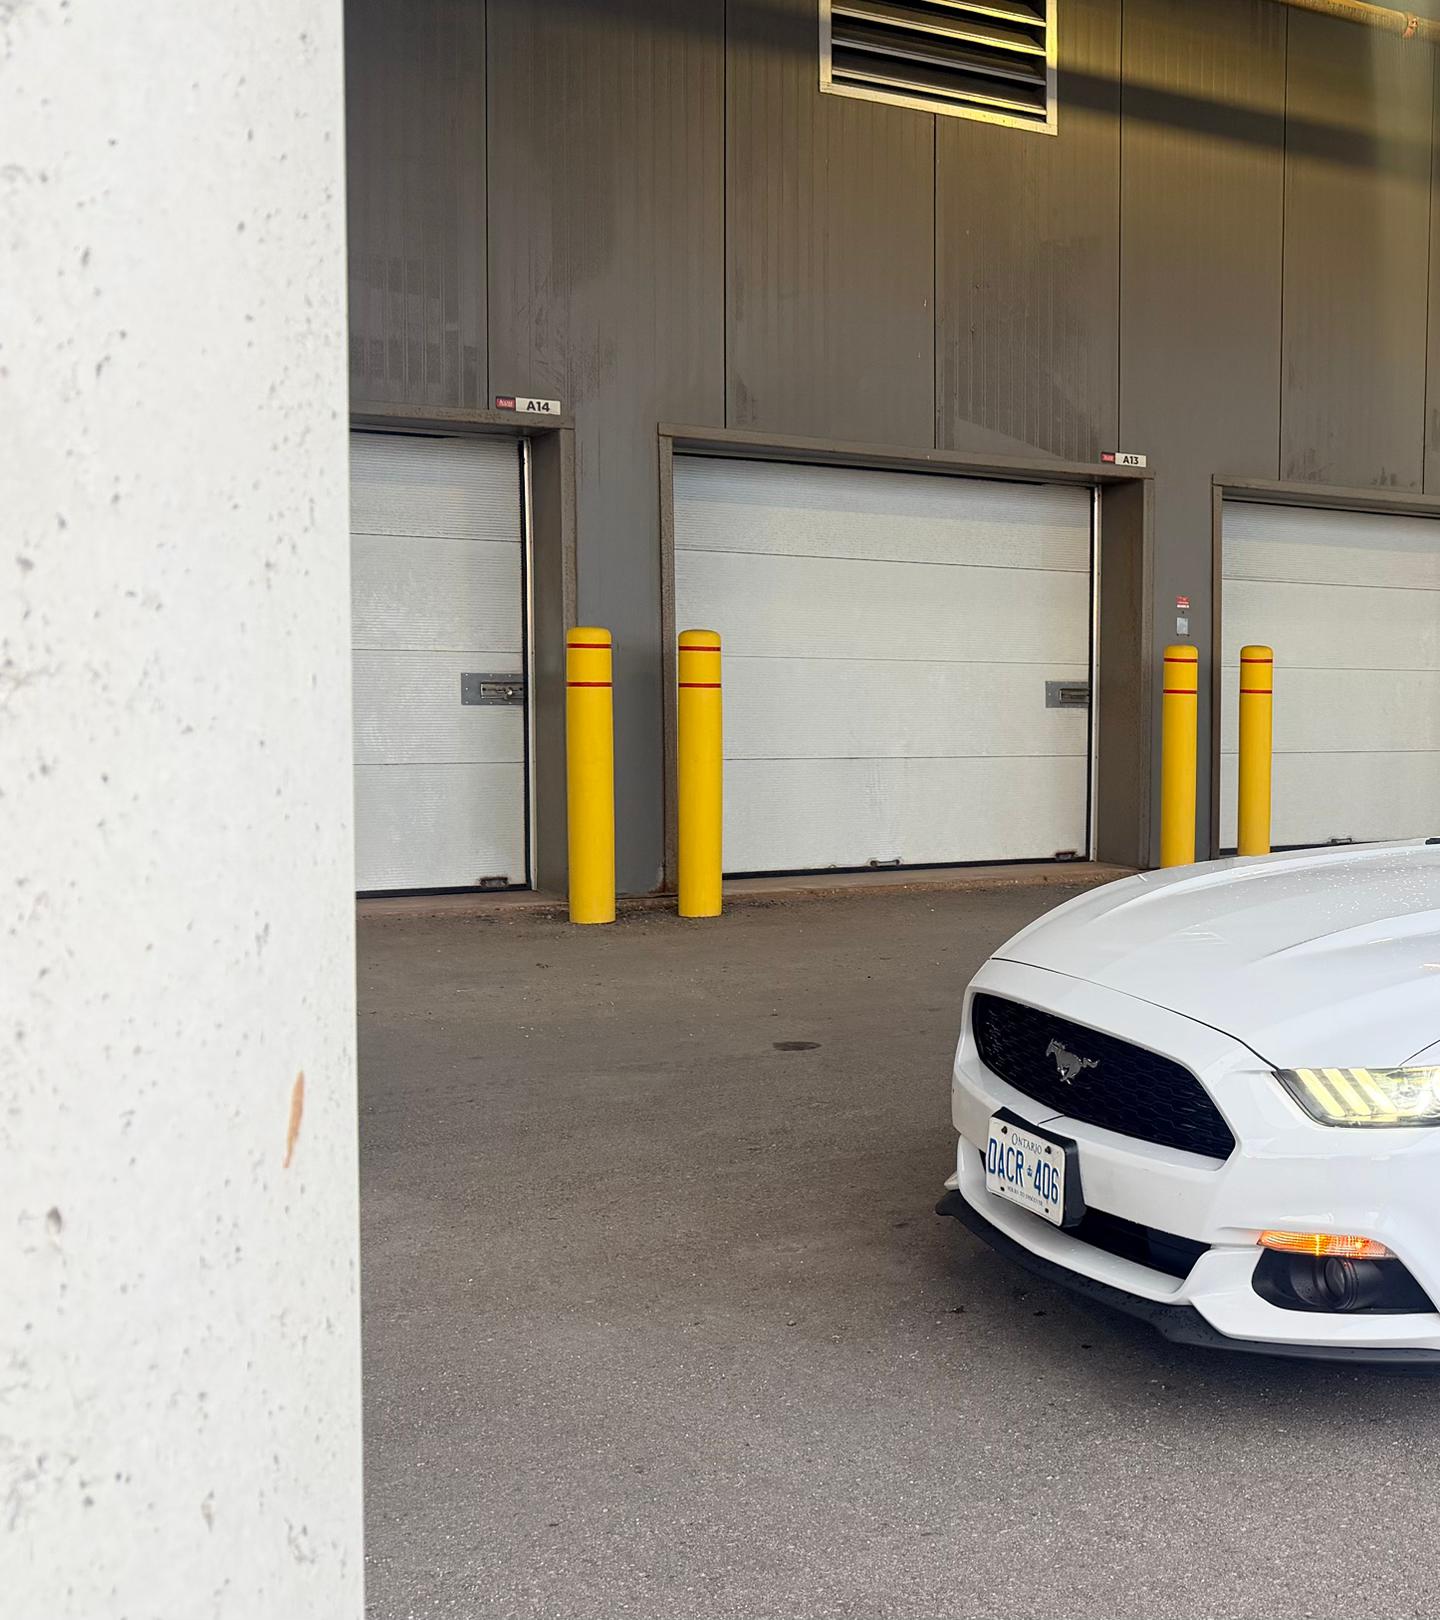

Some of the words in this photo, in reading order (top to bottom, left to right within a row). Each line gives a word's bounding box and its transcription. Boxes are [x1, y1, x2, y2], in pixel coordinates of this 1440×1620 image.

[527, 400, 550, 412] A14
[1122, 455, 1139, 465] A13
[987, 1137, 1025, 1188] DACR
[1033, 1159, 1061, 1205] 406
